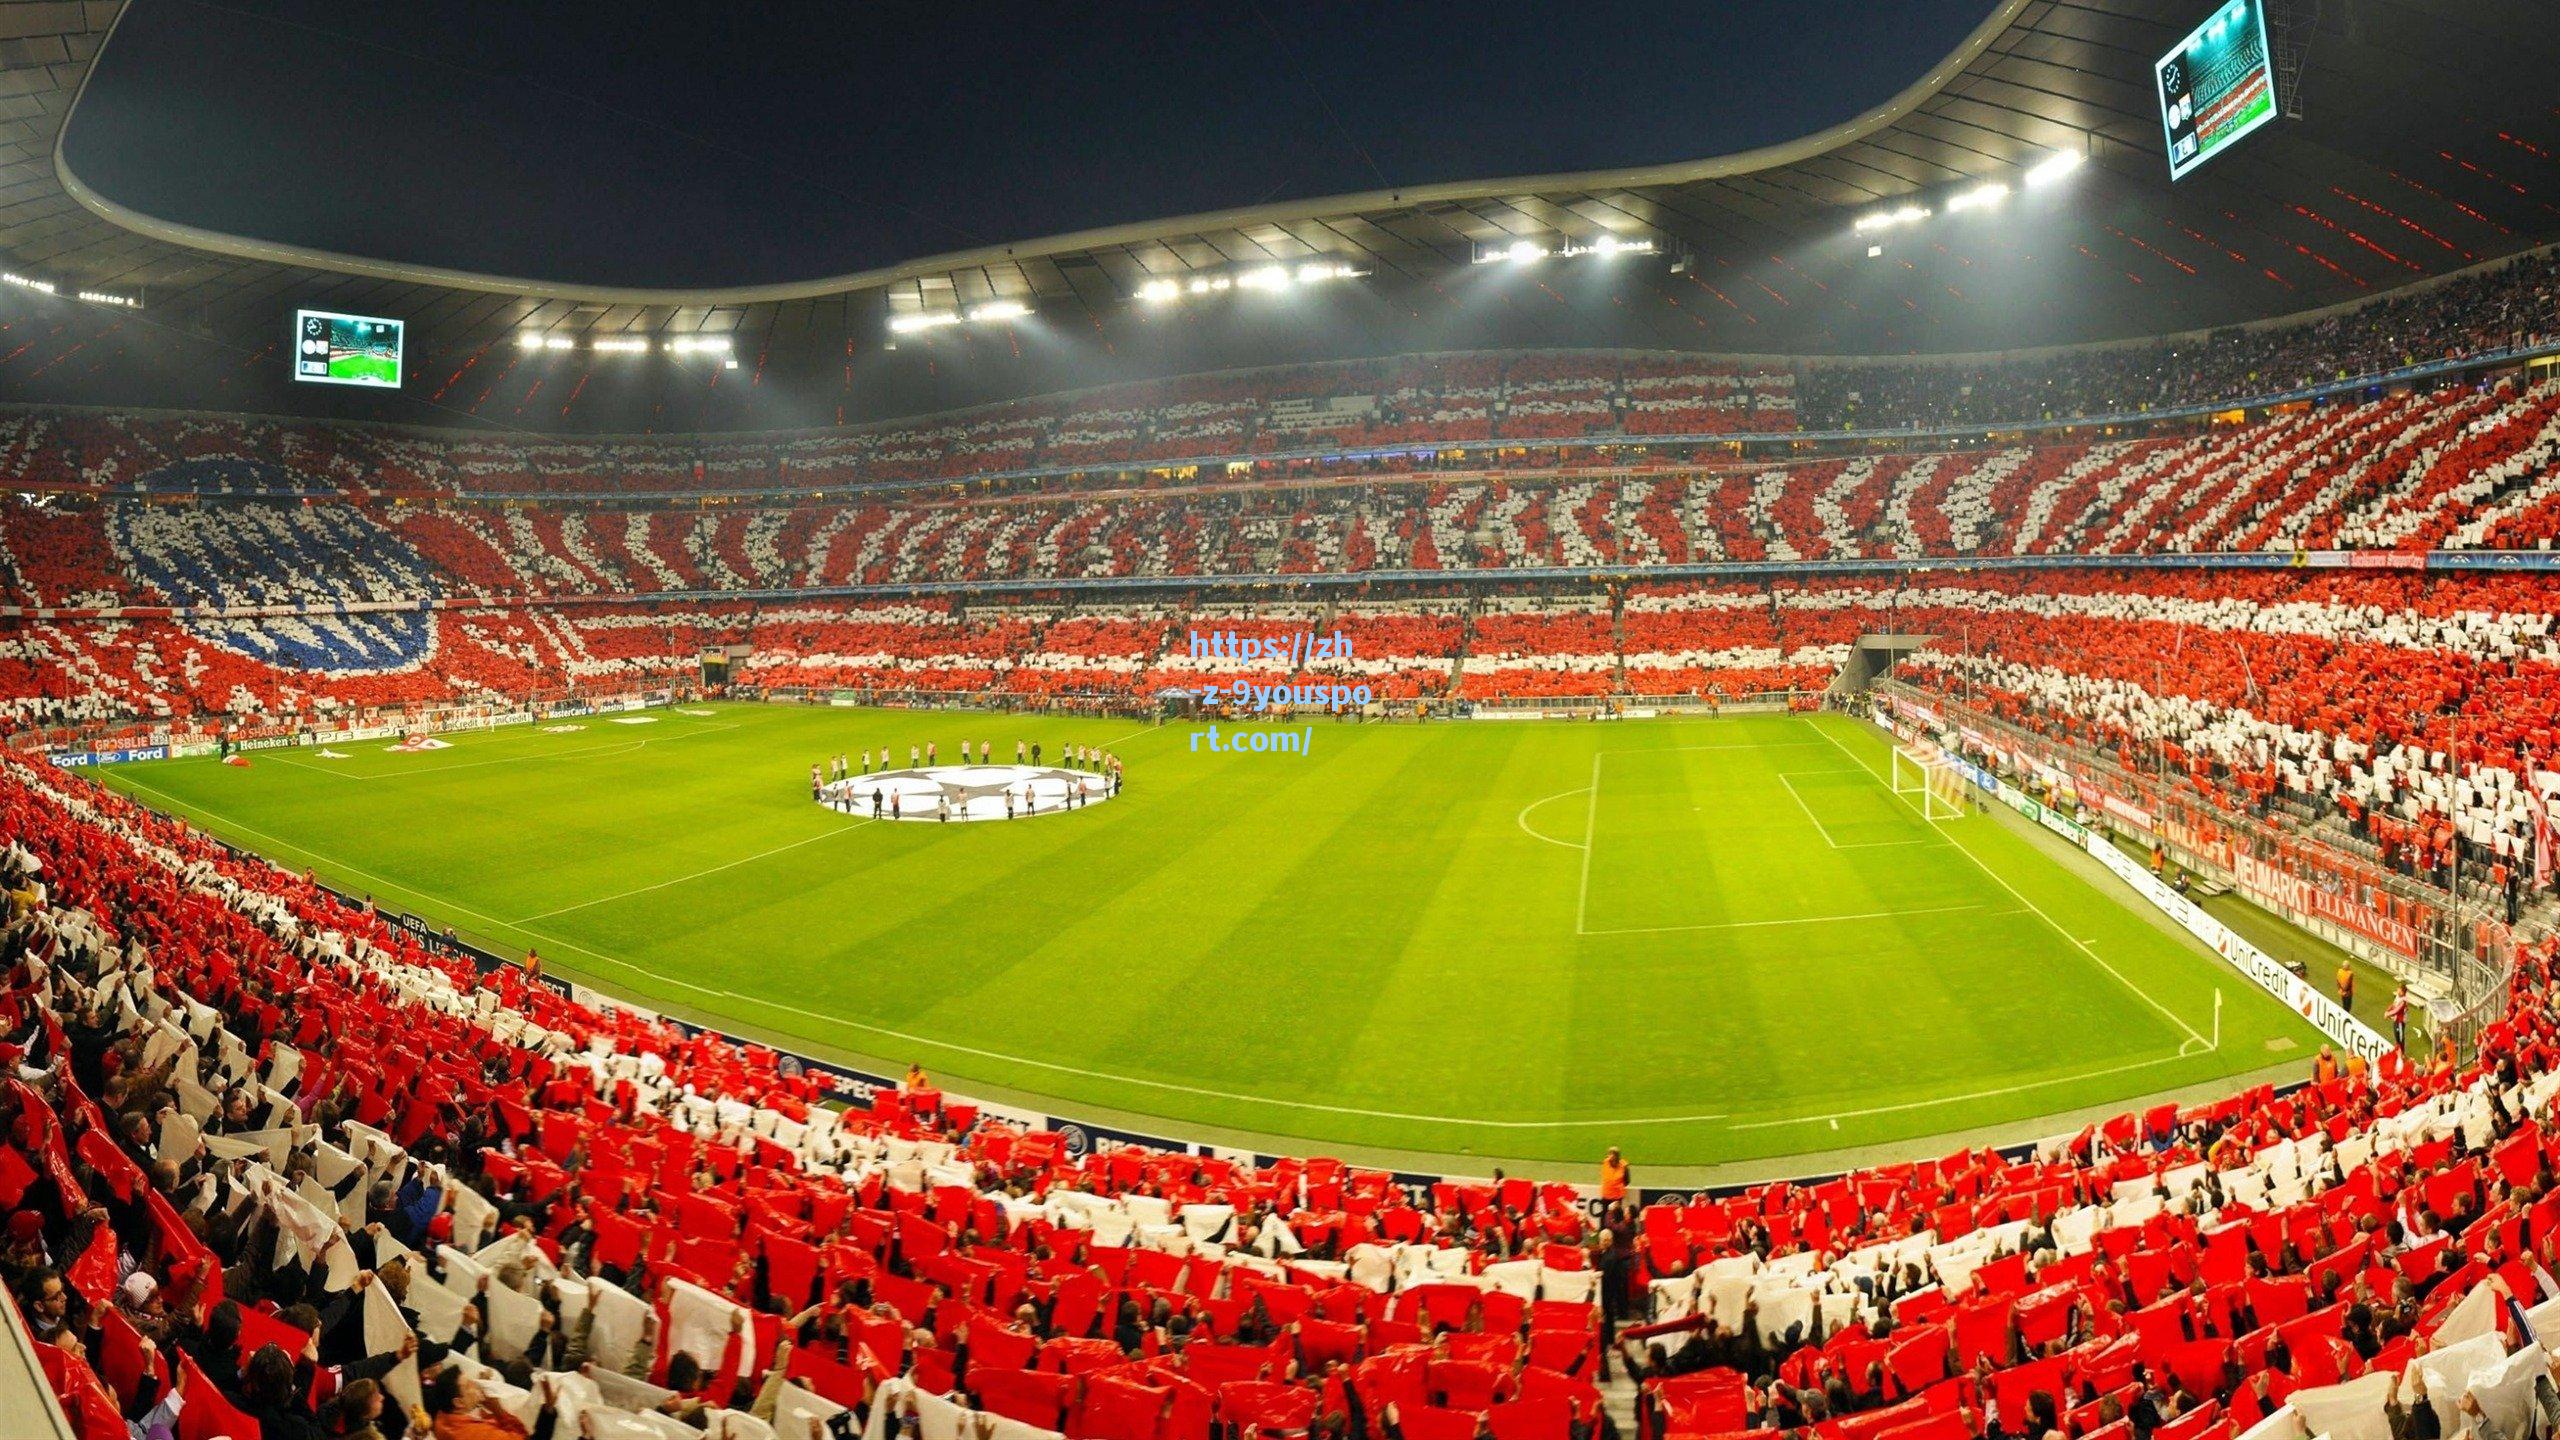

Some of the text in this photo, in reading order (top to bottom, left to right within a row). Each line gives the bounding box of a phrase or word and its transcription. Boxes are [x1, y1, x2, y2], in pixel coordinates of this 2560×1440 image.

[52, 755, 88, 767] Ford
[128, 747, 163, 761] Ford
[240, 737, 288, 751] Heineken
[2233, 852, 2312, 915] NEUMARKT
[402, 914, 427, 934] UEFA
[2316, 890, 2415, 951] ELLWANGEN
[2230, 936, 2290, 1001] UniCredit
[2316, 997, 2392, 1066] UniCredi
